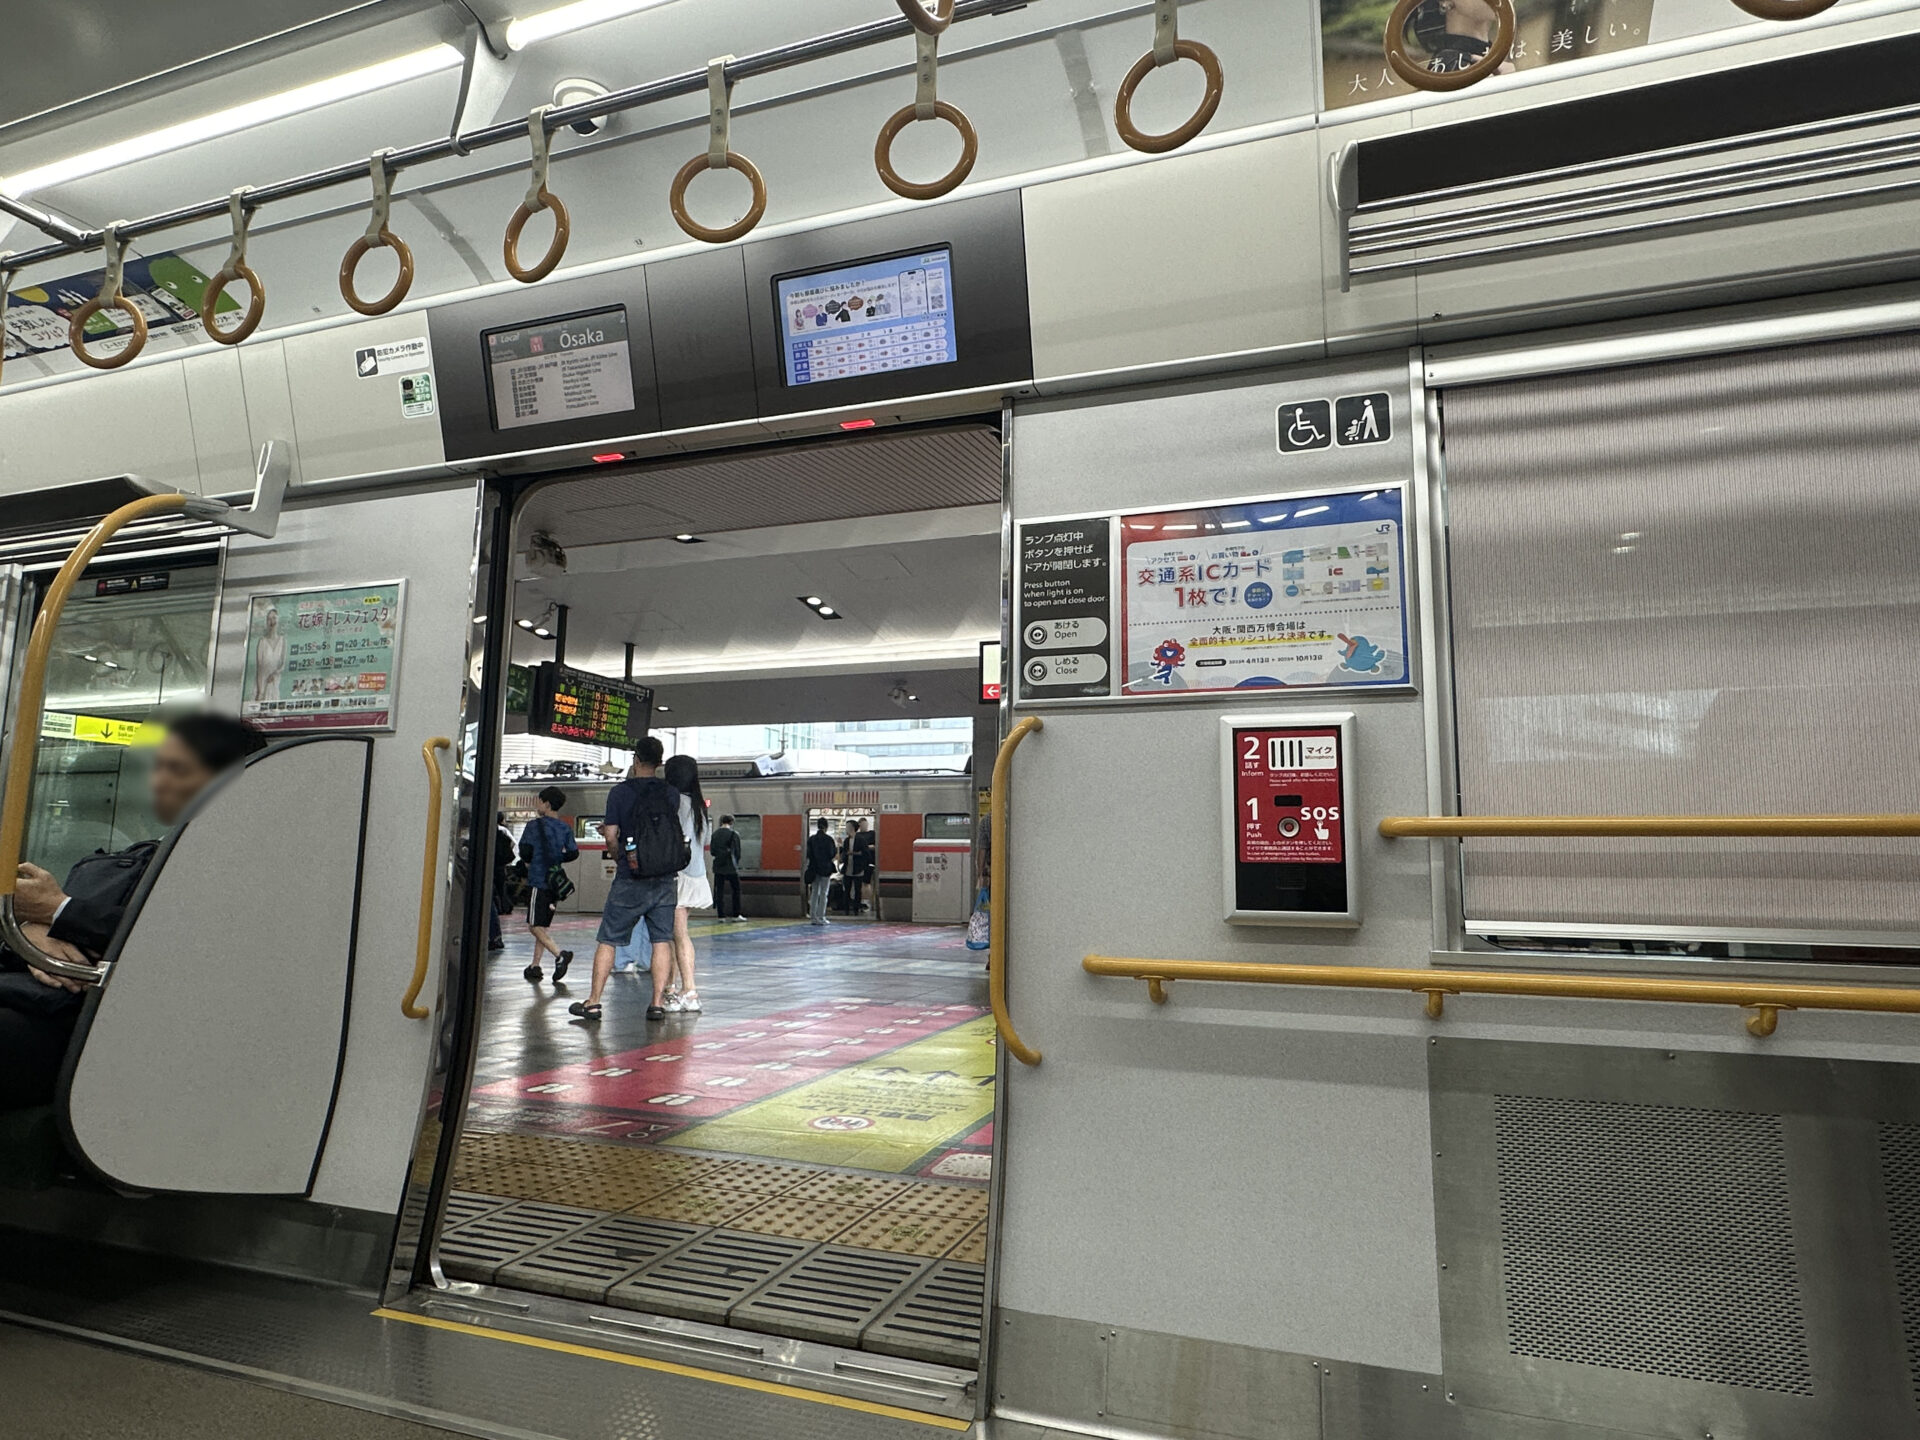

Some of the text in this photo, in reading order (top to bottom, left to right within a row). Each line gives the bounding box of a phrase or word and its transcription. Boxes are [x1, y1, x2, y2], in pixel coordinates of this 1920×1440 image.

[1349, 22, 1641, 96] 大人あしは、美しい。
[560, 328, 604, 349] Ōsaka
[377, 341, 424, 357] 防犯カメラ作動中
[1376, 523, 1391, 533] JR
[1025, 531, 1084, 546] ランプ点灯中
[1025, 544, 1094, 559] ボタンを押せば
[1211, 551, 1239, 560] お買い物
[1025, 558, 1107, 573] ドアが開閉します。
[1151, 556, 1176, 564] アクセス
[1138, 558, 1272, 585] 交通系ICカード
[1044, 580, 1070, 588] button
[1046, 588, 1064, 598] light
[1033, 599, 1052, 608] open
[1053, 597, 1067, 605] and
[1068, 596, 1086, 604] close
[299, 607, 389, 630] 花嫁ドレスフェスタ
[1054, 621, 1080, 630] あける
[1212, 621, 1306, 635] 大阪・関西万博会場は
[1054, 631, 1078, 640] Open
[1189, 630, 1332, 646] 全面的キャッシュレス決済です。
[1055, 656, 1080, 666] しめる
[1055, 666, 1078, 675] Close
[1243, 736, 1260, 760] 2
[1306, 746, 1332, 754] マイク
[1246, 797, 1259, 821] 1
[1301, 806, 1340, 821] SOS
